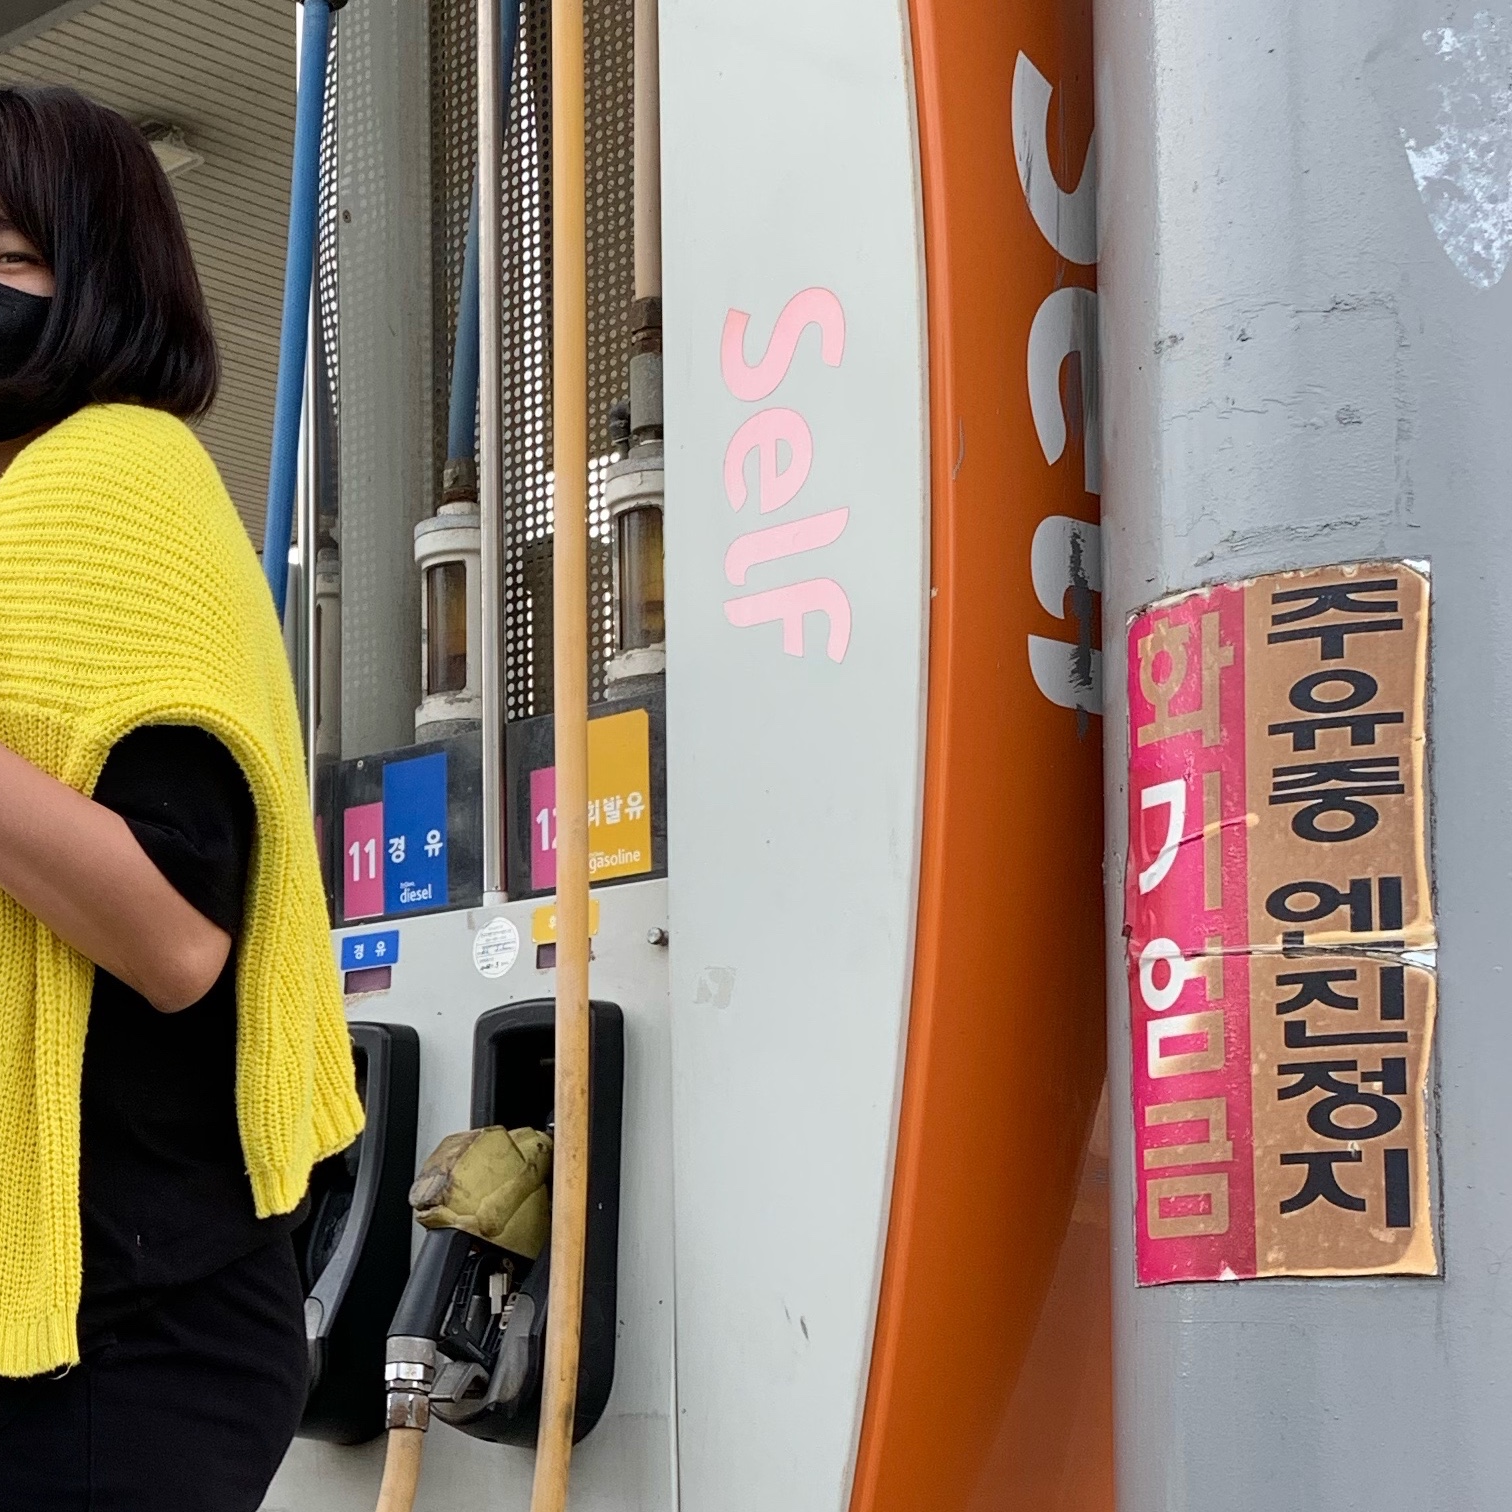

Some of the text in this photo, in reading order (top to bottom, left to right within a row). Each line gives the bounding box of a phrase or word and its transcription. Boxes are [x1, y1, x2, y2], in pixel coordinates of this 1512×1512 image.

[348, 838, 377, 882] 11
[589, 848, 641, 874] gasoline
[399, 883, 433, 904] diesel
[1265, 578, 1412, 1230] 주유중 엔진정지
[1136, 611, 1234, 1240] 화기엄금
